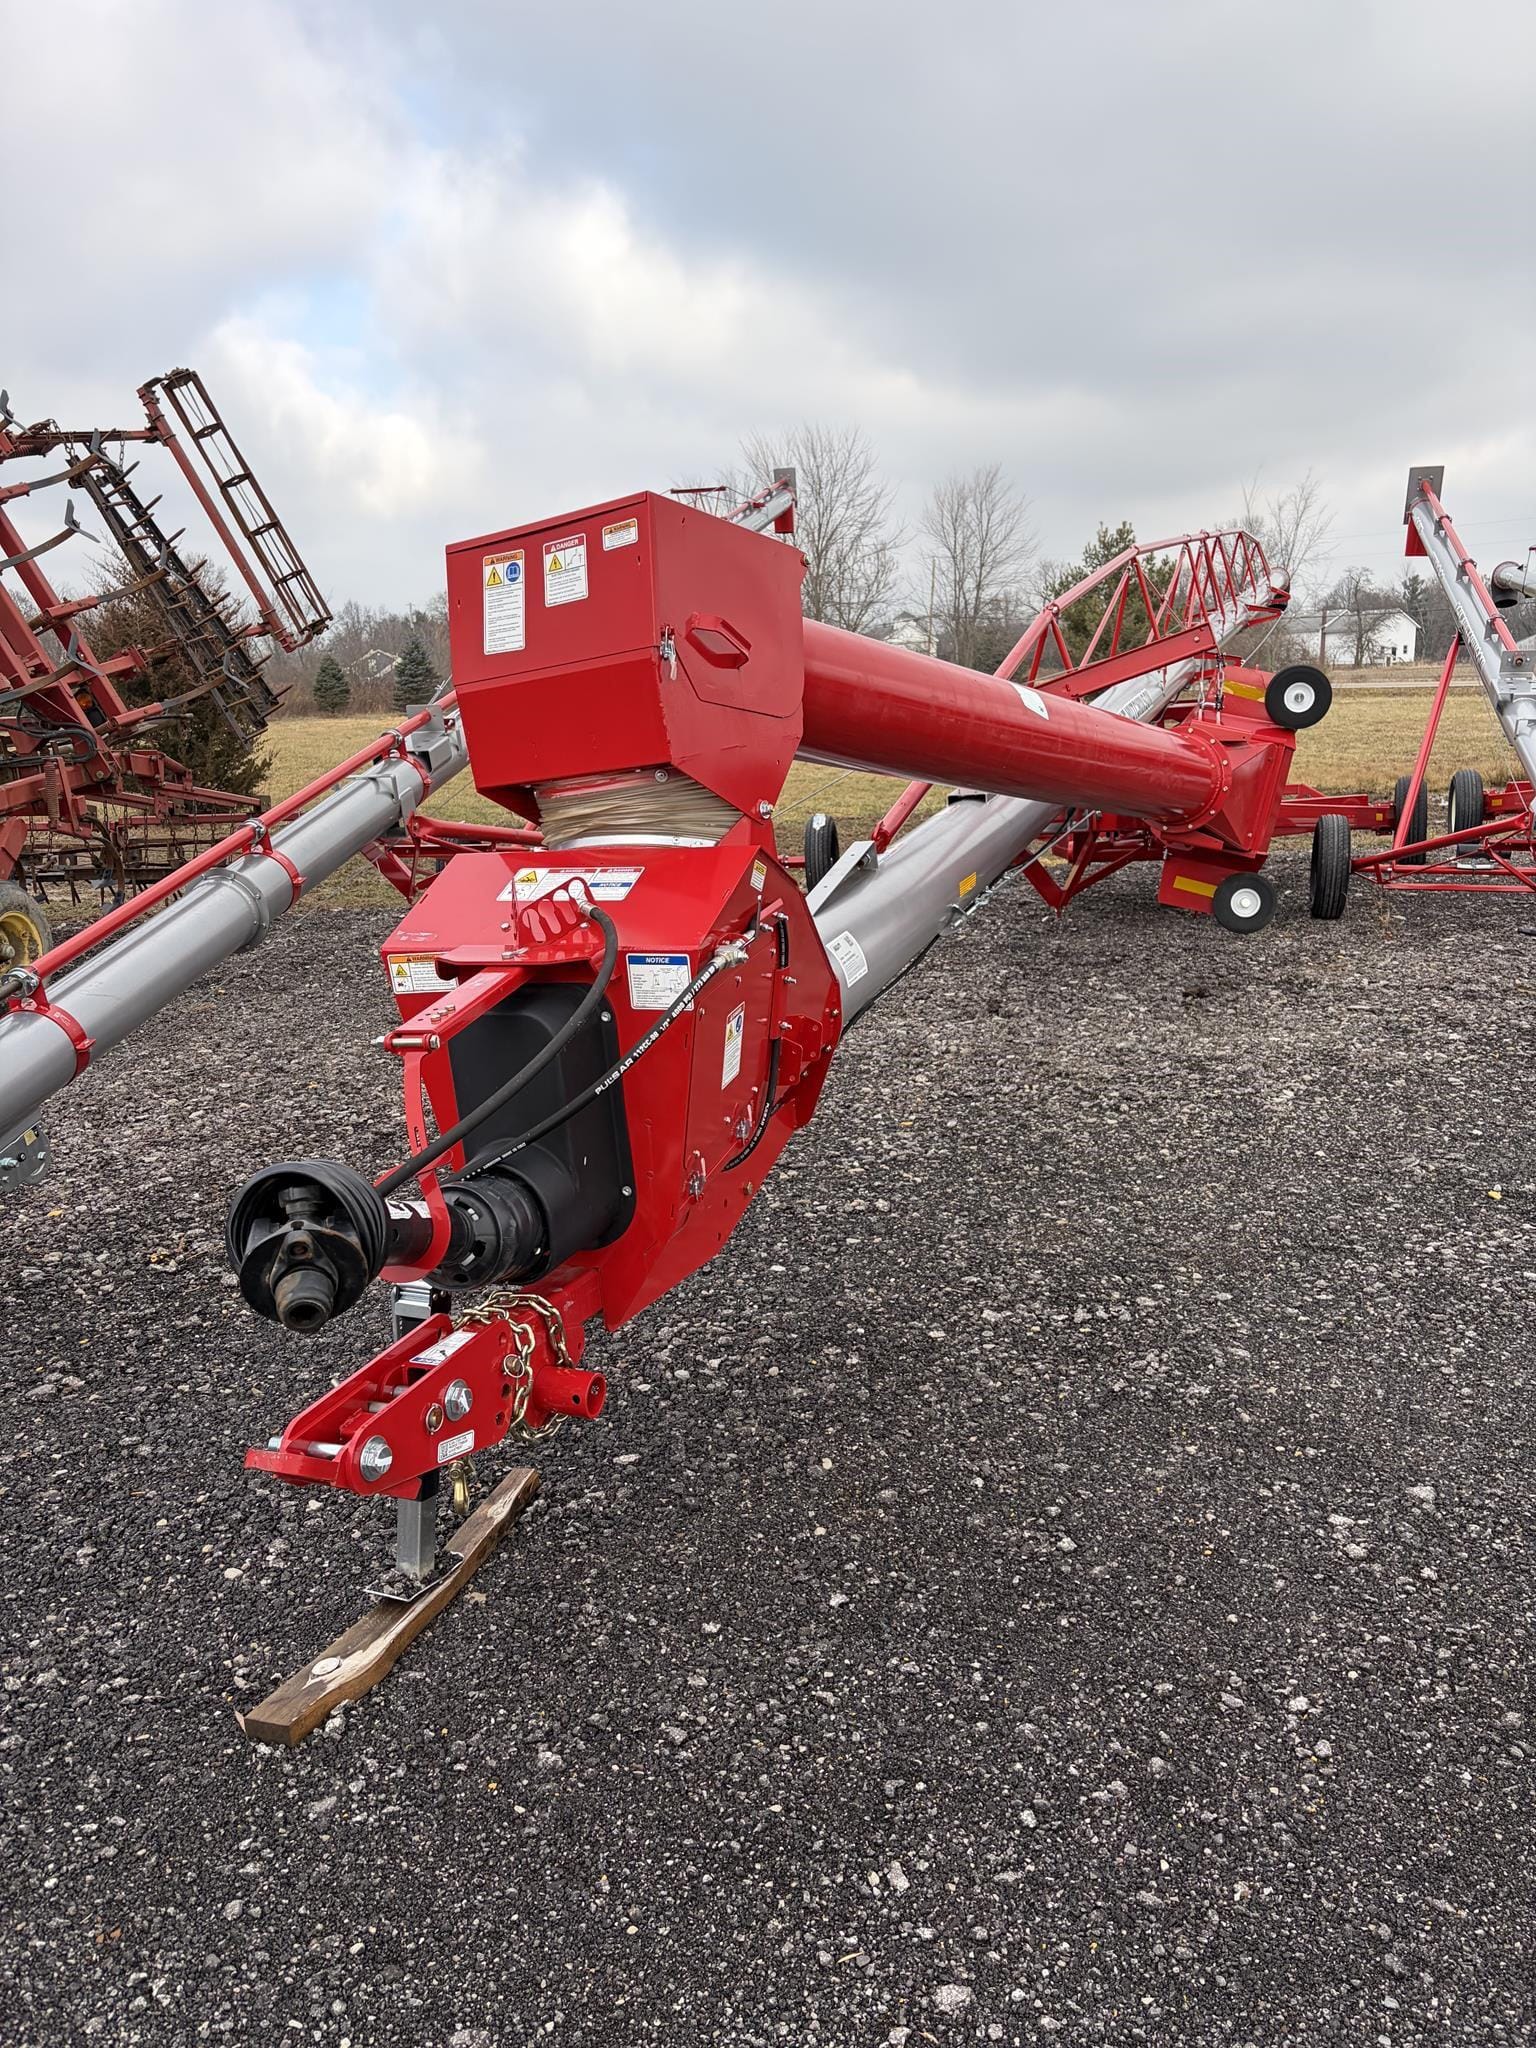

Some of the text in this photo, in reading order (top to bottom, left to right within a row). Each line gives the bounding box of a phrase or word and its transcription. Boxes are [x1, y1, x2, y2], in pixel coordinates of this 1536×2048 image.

[556, 538, 579, 550] DANGER
[594, 1057, 634, 1095] PULSAR
[671, 1001, 685, 1018] 4000
